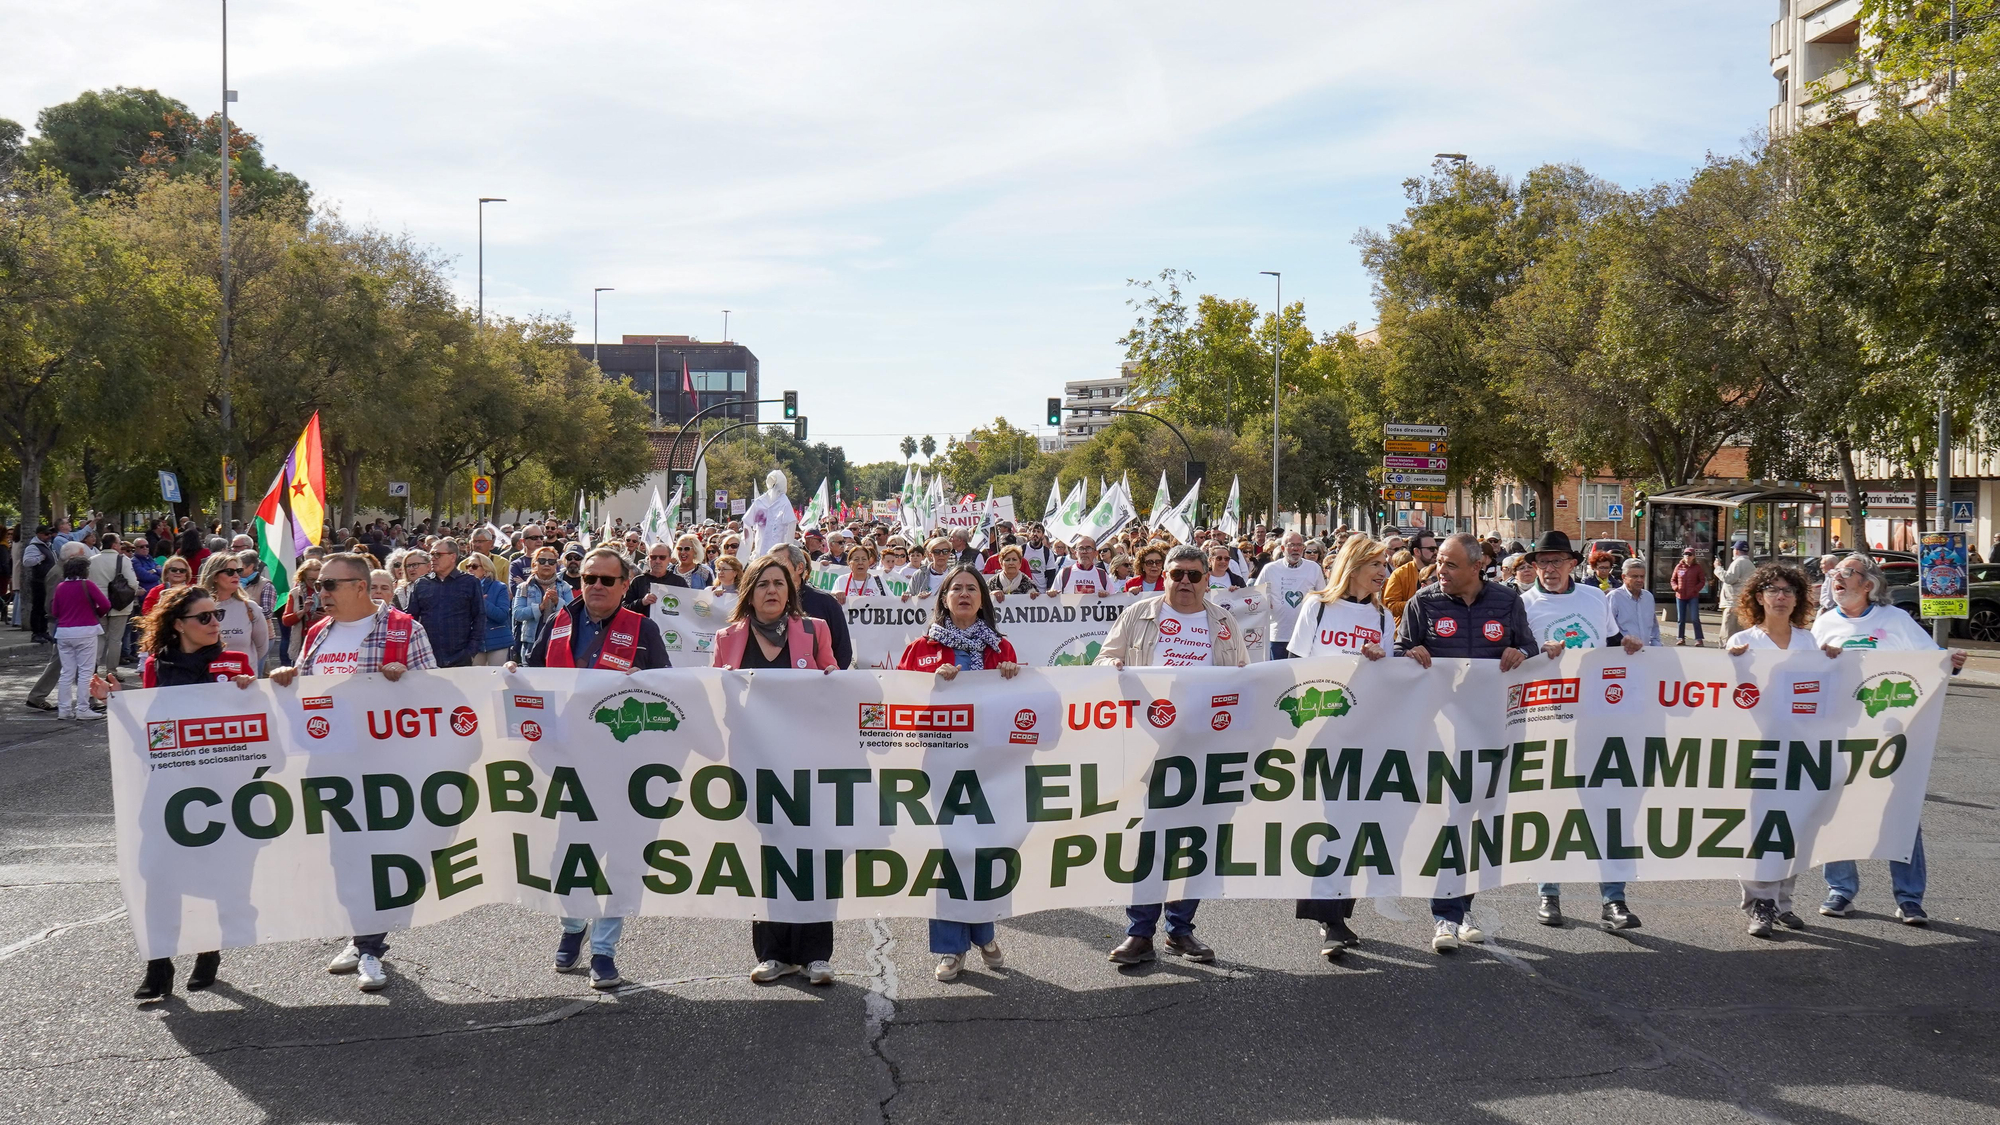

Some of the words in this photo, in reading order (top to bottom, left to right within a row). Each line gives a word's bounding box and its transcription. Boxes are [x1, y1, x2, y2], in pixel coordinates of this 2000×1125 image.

[1834, 493, 1849, 503] clínic
[1886, 494, 1909, 503] victoria
[847, 603, 927, 625] PÚBLICO
[994, 605, 1077, 624] SANIDAD
[1164, 619, 1180, 630] UGT
[1438, 619, 1455, 629] UGT
[1485, 622, 1501, 632] UGT
[1080, 630, 1108, 639] ANDALUZA
[1191, 626, 1209, 635] UGT
[1355, 627, 1374, 638] UGT
[612, 632, 632, 641] CCOO
[1320, 629, 1357, 648] UGT
[1173, 638, 1212, 648] Primero
[602, 653, 625, 666] CCOO
[1163, 648, 1208, 661] Sanidad
[918, 656, 938, 666] UGT
[323, 666, 334, 674] DE
[1524, 682, 1577, 703] CCOO
[1658, 680, 1728, 708] UGT
[1529, 705, 1536, 713] de
[1537, 704, 1562, 712] sanidad
[894, 709, 969, 726] CCOO
[1068, 700, 1141, 731] UGT
[1527, 713, 1574, 723] sociosanitarios
[366, 706, 443, 740] UGT
[183, 718, 265, 743] CCOO
[859, 729, 903, 738] federación
[918, 731, 952, 739] sanidad
[866, 740, 903, 748] sectores
[904, 740, 969, 749] sociosanitarios
[150, 747, 197, 760] federación
[198, 746, 210, 755] de
[212, 743, 248, 754] sanidad
[157, 759, 196, 770] sectores
[198, 752, 267, 766] sociosanitarios
[164, 760, 598, 848] CÓRDOBA
[627, 763, 996, 827] CONTRA
[1025, 762, 1119, 823] EL
[1147, 733, 1908, 810] DESMANTELAMIENTO
[371, 838, 484, 912] DE
[512, 832, 613, 897] LA
[641, 839, 1022, 902] SANIDAD
[1049, 817, 1395, 888] PÚBLICA
[1419, 807, 1796, 877] ANDALUZA
